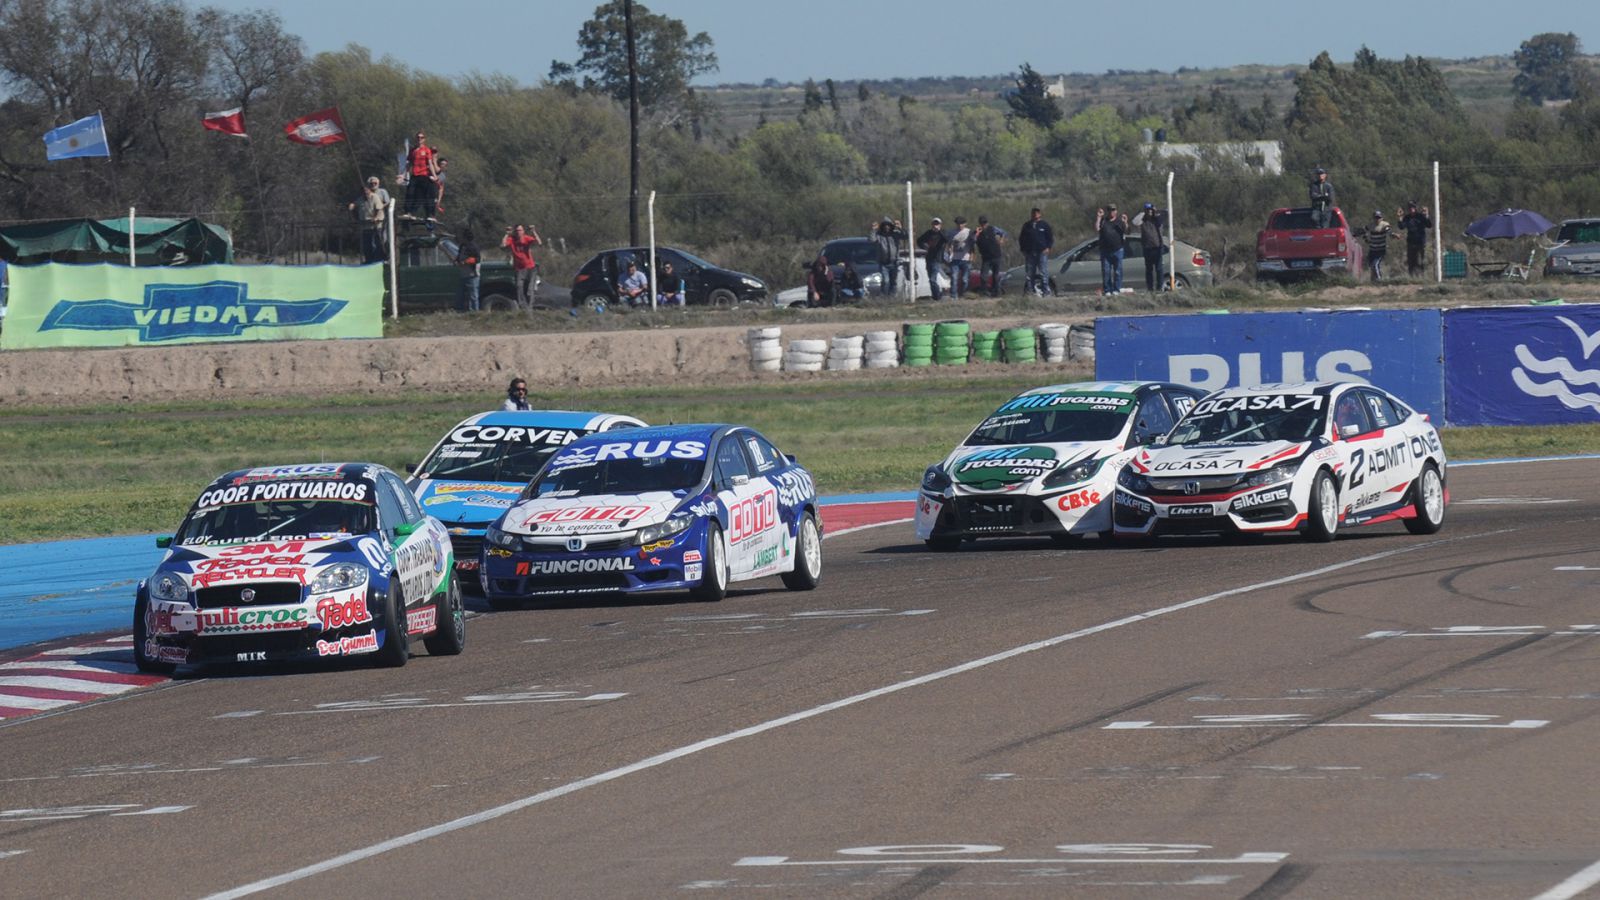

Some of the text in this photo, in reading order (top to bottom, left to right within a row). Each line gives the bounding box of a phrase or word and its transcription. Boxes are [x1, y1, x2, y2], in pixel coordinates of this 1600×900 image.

[132, 305, 278, 325] VIEDMA
[1193, 396, 1285, 415] OCASA
[594, 440, 707, 461] RUS
[1368, 442, 1406, 477] ADMIT
[1411, 430, 1439, 459] ONE
[960, 459, 1057, 472] JUGADAS
[1008, 467, 1041, 476] .com
[1154, 460, 1219, 471] OCASA
[1349, 447, 1365, 491] 2
[198, 484, 249, 508] COOP.
[251, 482, 368, 501] PORTUARIOS
[1115, 492, 1151, 512] sikkens
[1233, 488, 1288, 510] sikkens
[526, 506, 651, 523] COTO
[730, 489, 775, 545] COTO
[182, 534, 213, 546] ELOY
[218, 542, 305, 557] 3M
[531, 557, 636, 575] FUNCIONAL
[195, 607, 308, 634] julicroc
[236, 651, 267, 662] MTK
